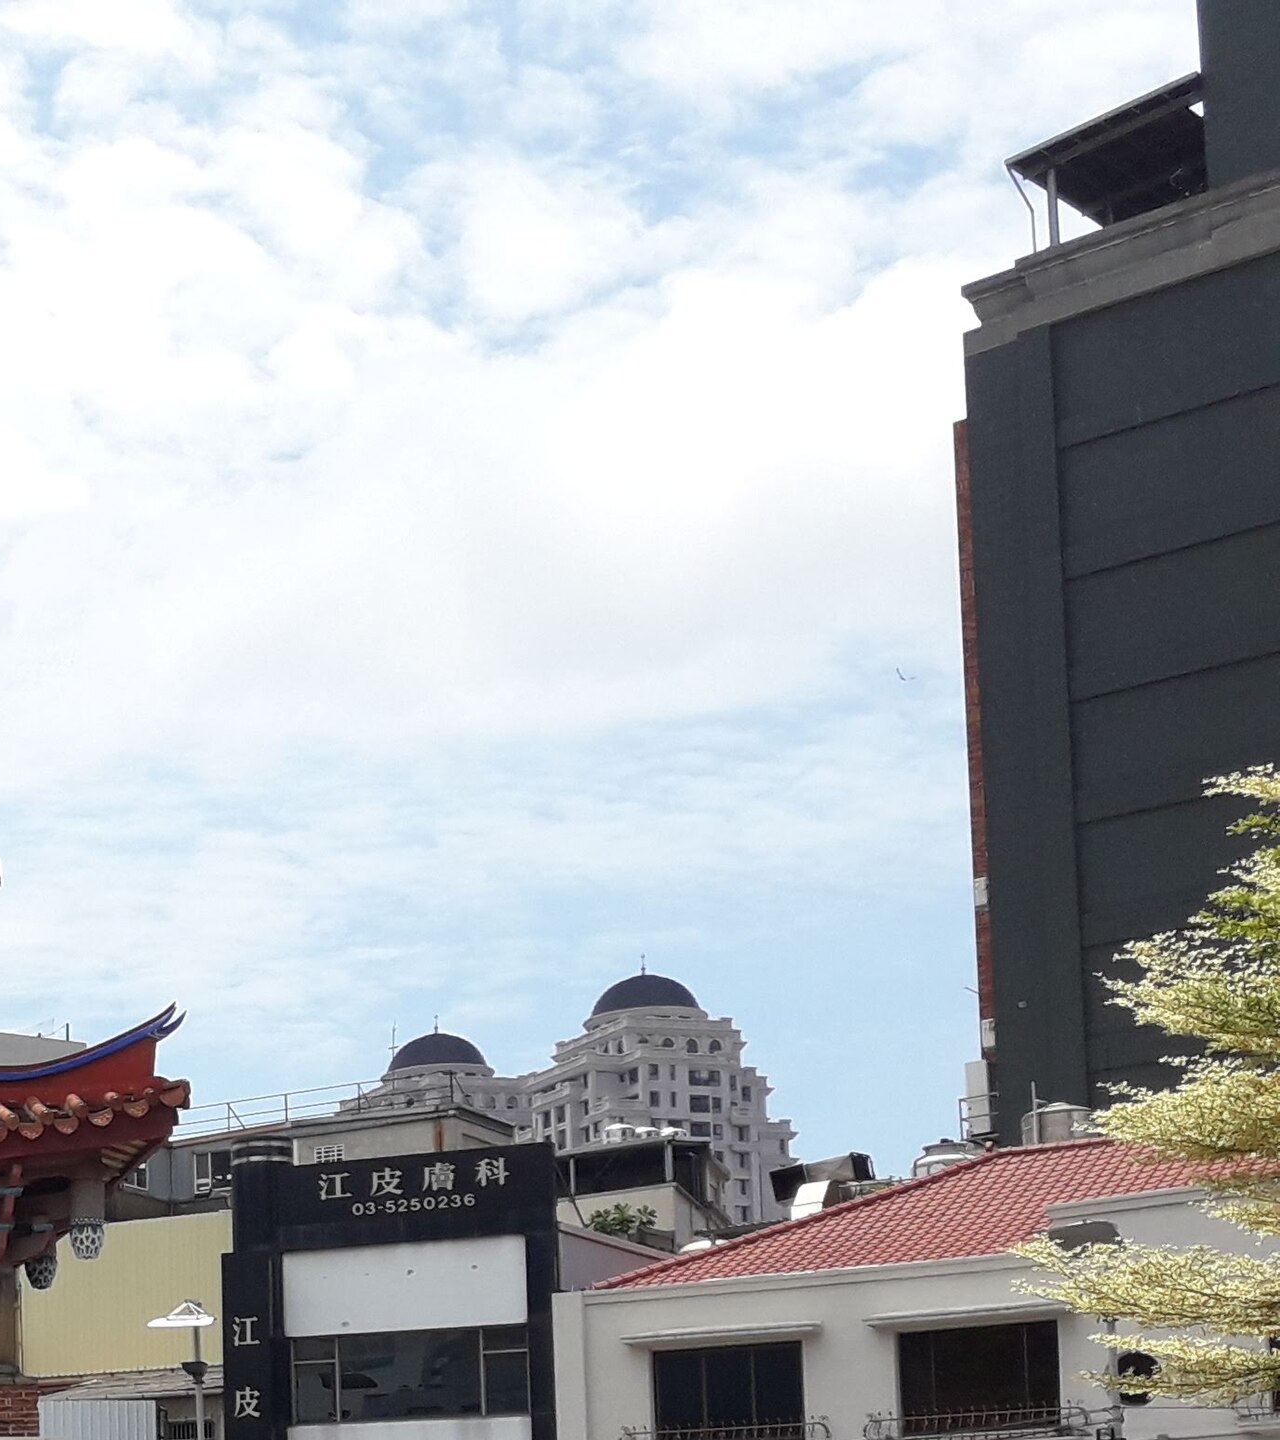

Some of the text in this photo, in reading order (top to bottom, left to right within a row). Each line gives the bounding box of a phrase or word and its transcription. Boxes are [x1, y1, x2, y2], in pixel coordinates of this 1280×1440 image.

[317, 1156, 511, 1201] 江皮膚科
[351, 1193, 476, 1216] 03-5250236
